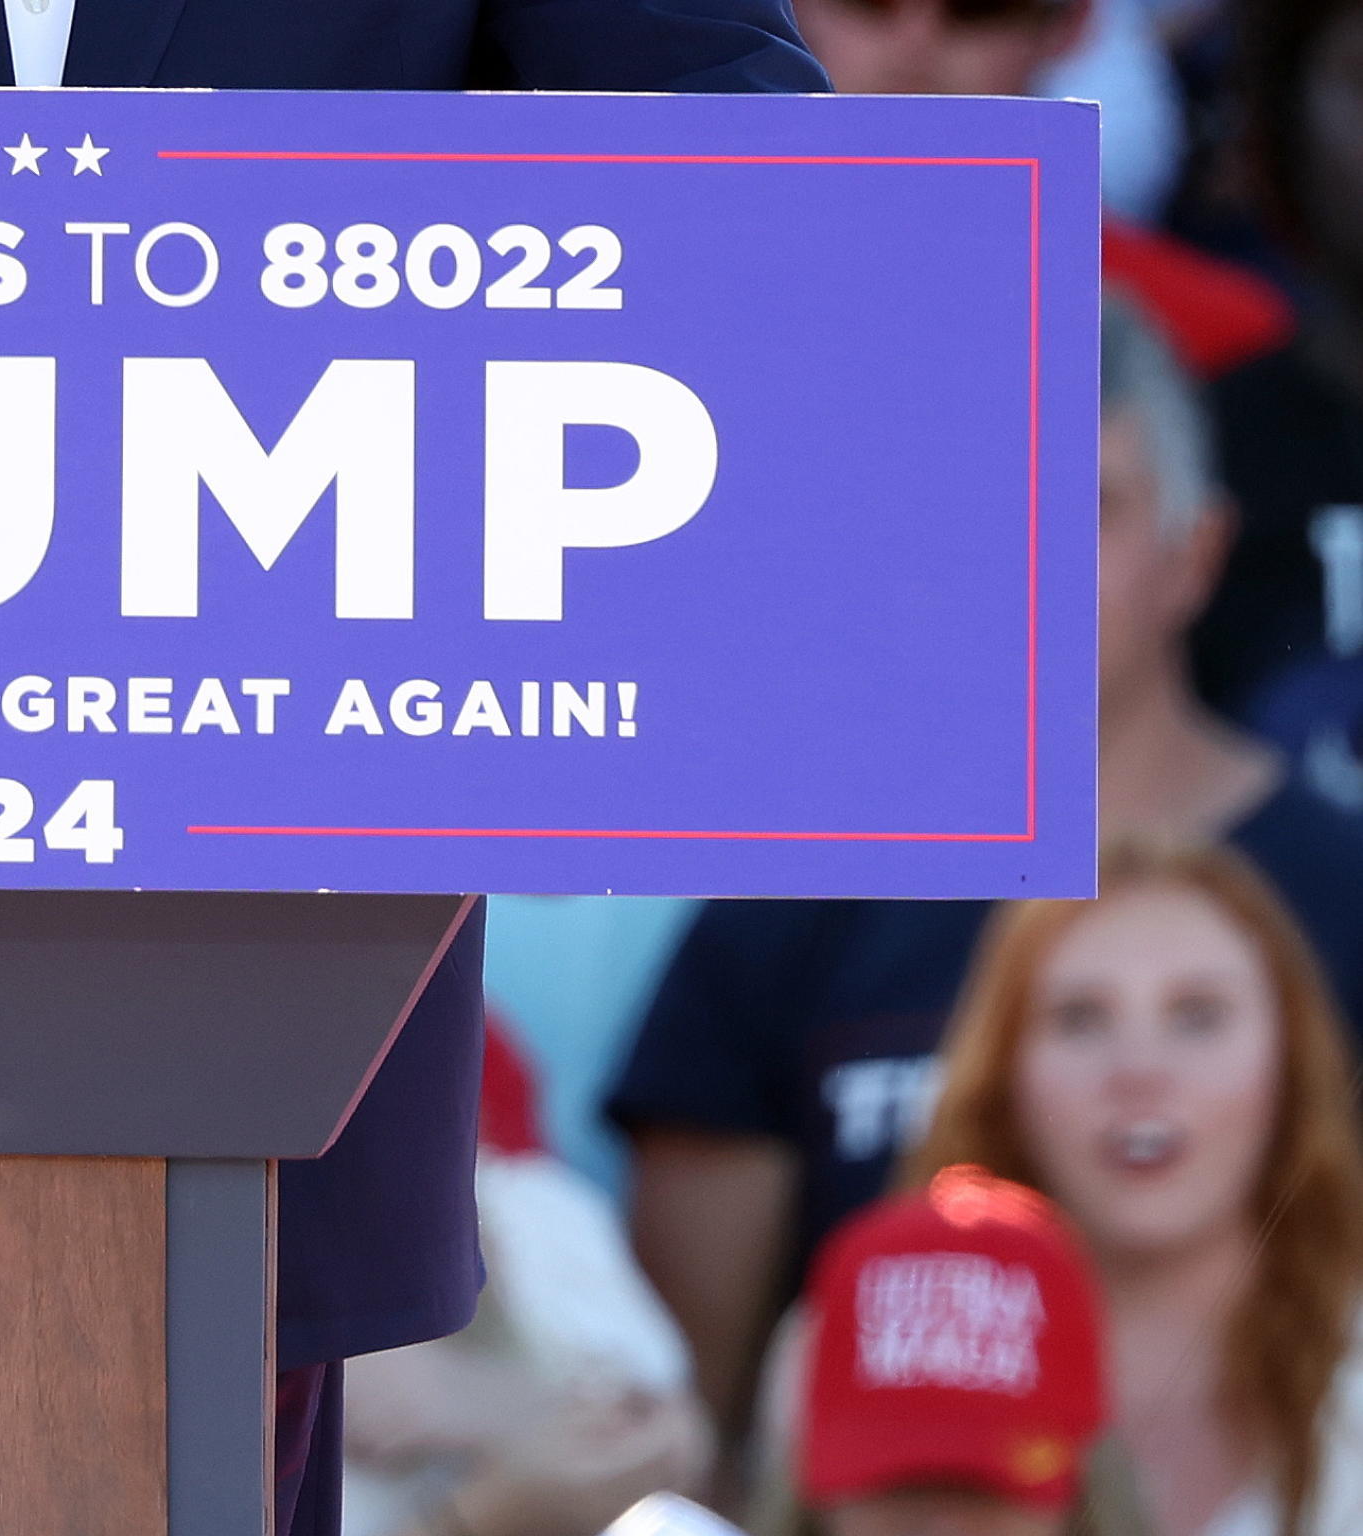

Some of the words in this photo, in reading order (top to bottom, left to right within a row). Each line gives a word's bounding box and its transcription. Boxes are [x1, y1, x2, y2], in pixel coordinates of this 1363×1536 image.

[66, 222, 219, 308] TO
[261, 223, 623, 309] 88022
[1, 675, 291, 735] GREAT
[325, 679, 637, 738] AGAIN!
